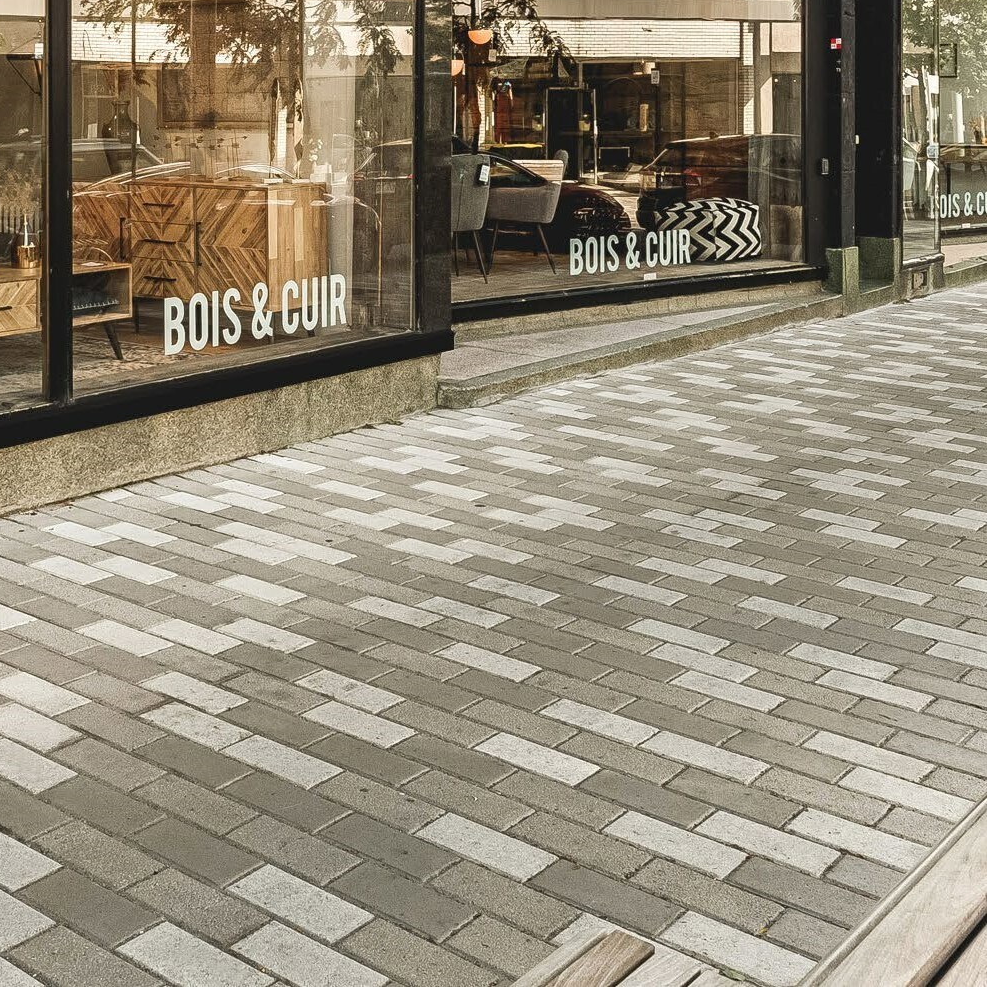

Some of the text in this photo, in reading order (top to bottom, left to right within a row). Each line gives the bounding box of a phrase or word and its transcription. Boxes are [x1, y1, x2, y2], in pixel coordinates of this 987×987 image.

[964, 191, 973, 217] &
[569, 228, 691, 276] BOIS & CUIR
[164, 273, 347, 356] BOIS & CUIR
